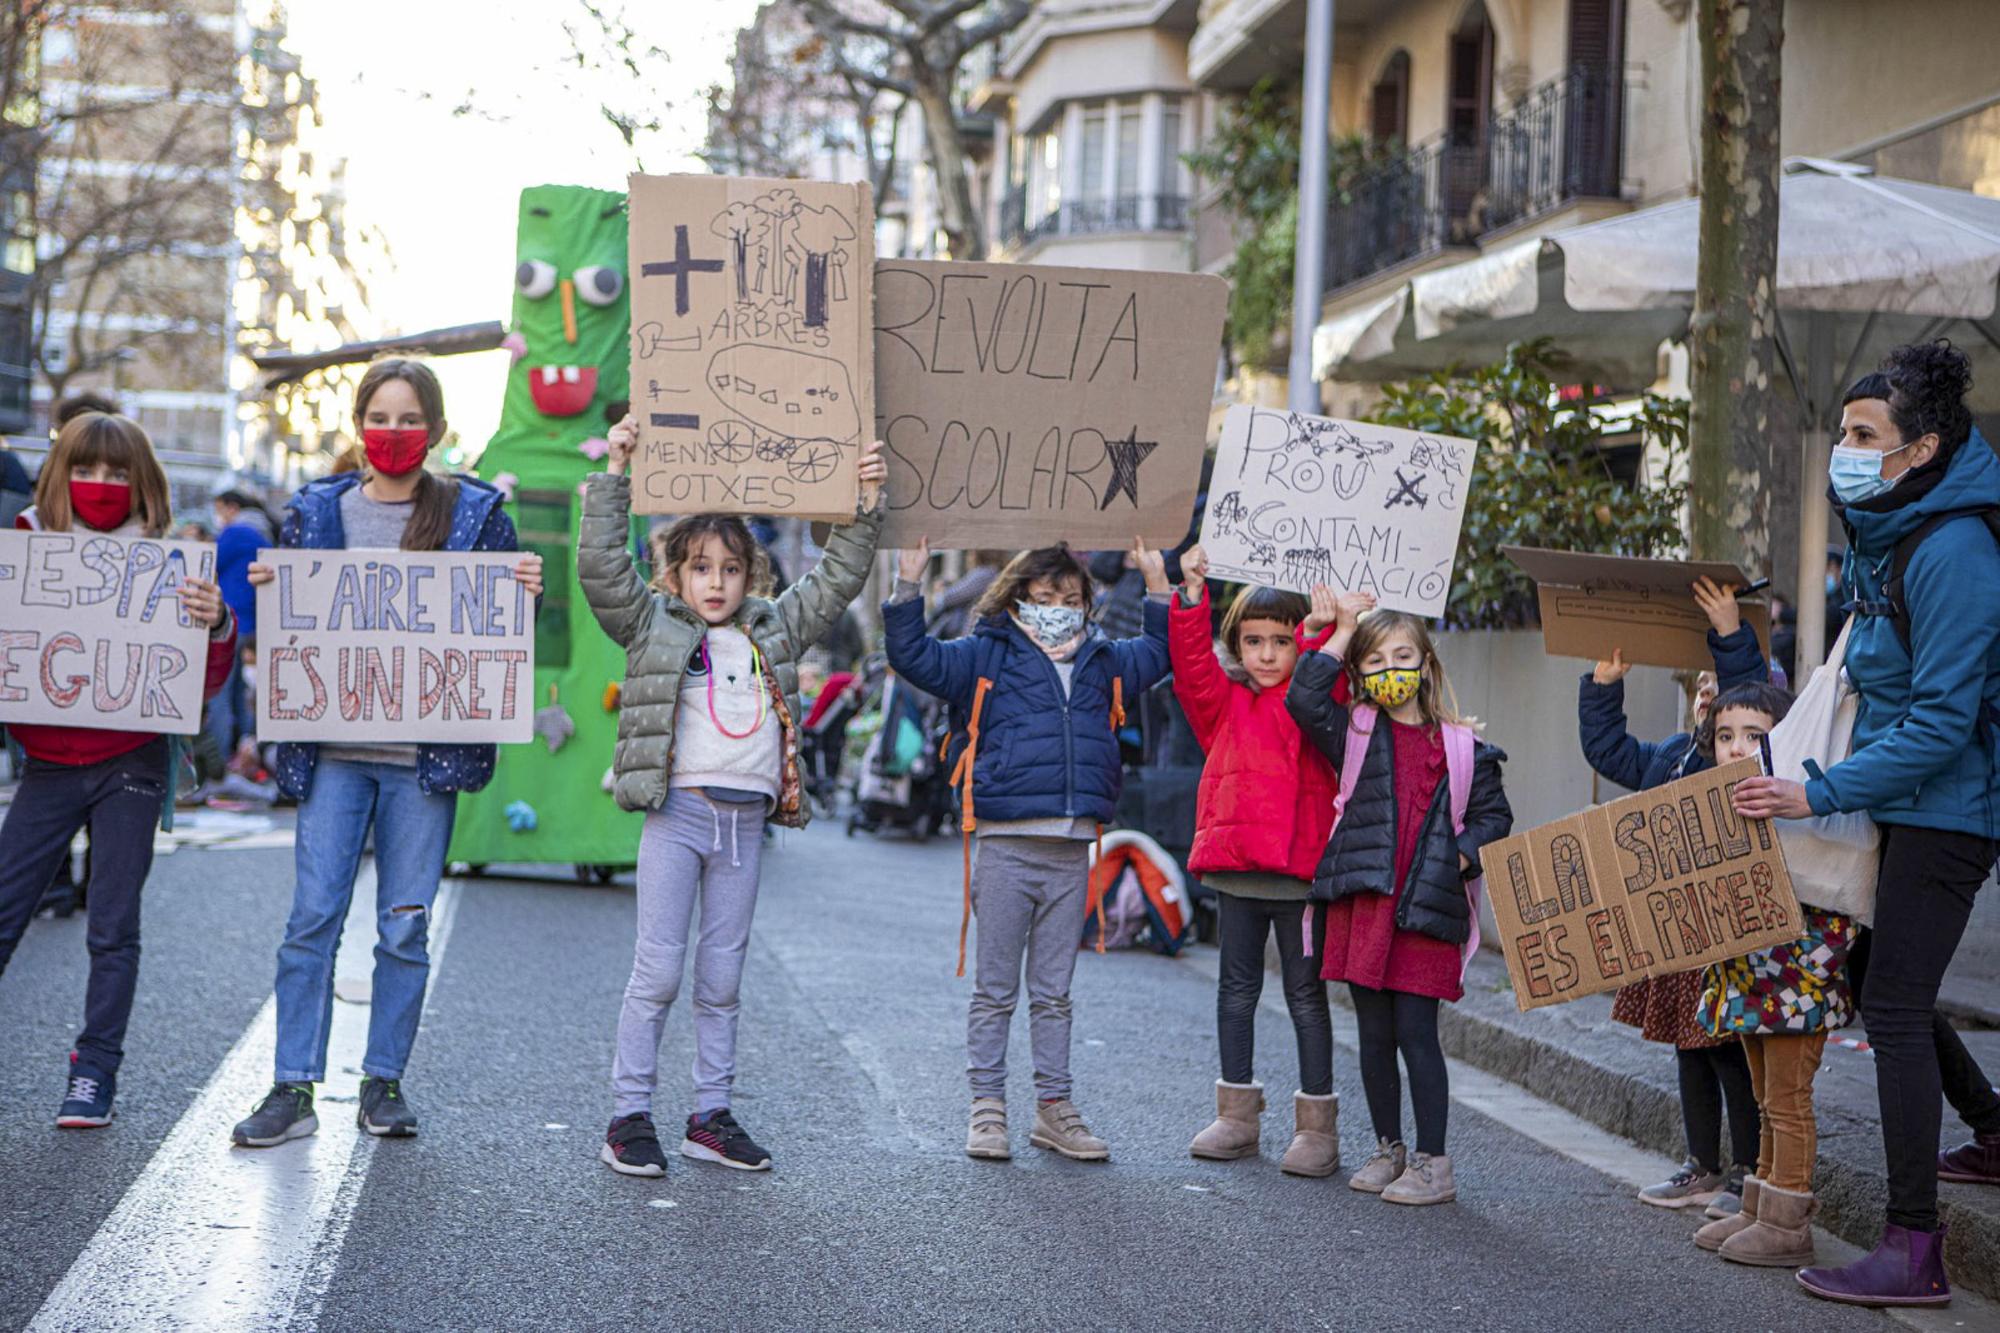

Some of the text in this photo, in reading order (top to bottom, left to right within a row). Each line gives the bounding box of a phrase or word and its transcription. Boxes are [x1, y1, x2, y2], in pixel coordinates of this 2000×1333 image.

[708, 308, 831, 348] ARBRES
[874, 268, 1139, 382] REVOLTA
[645, 440, 718, 465] MENYS
[645, 470, 796, 508] COTXES
[875, 414, 1108, 511] SCOLAR
[450, 563, 526, 637] NET
[1328, 558, 1450, 601] NACIÓ
[268, 634, 528, 722] ÉS UN DRET
[1507, 833, 1594, 925] LA
[1516, 861, 1789, 999] ES EL PRIMER
